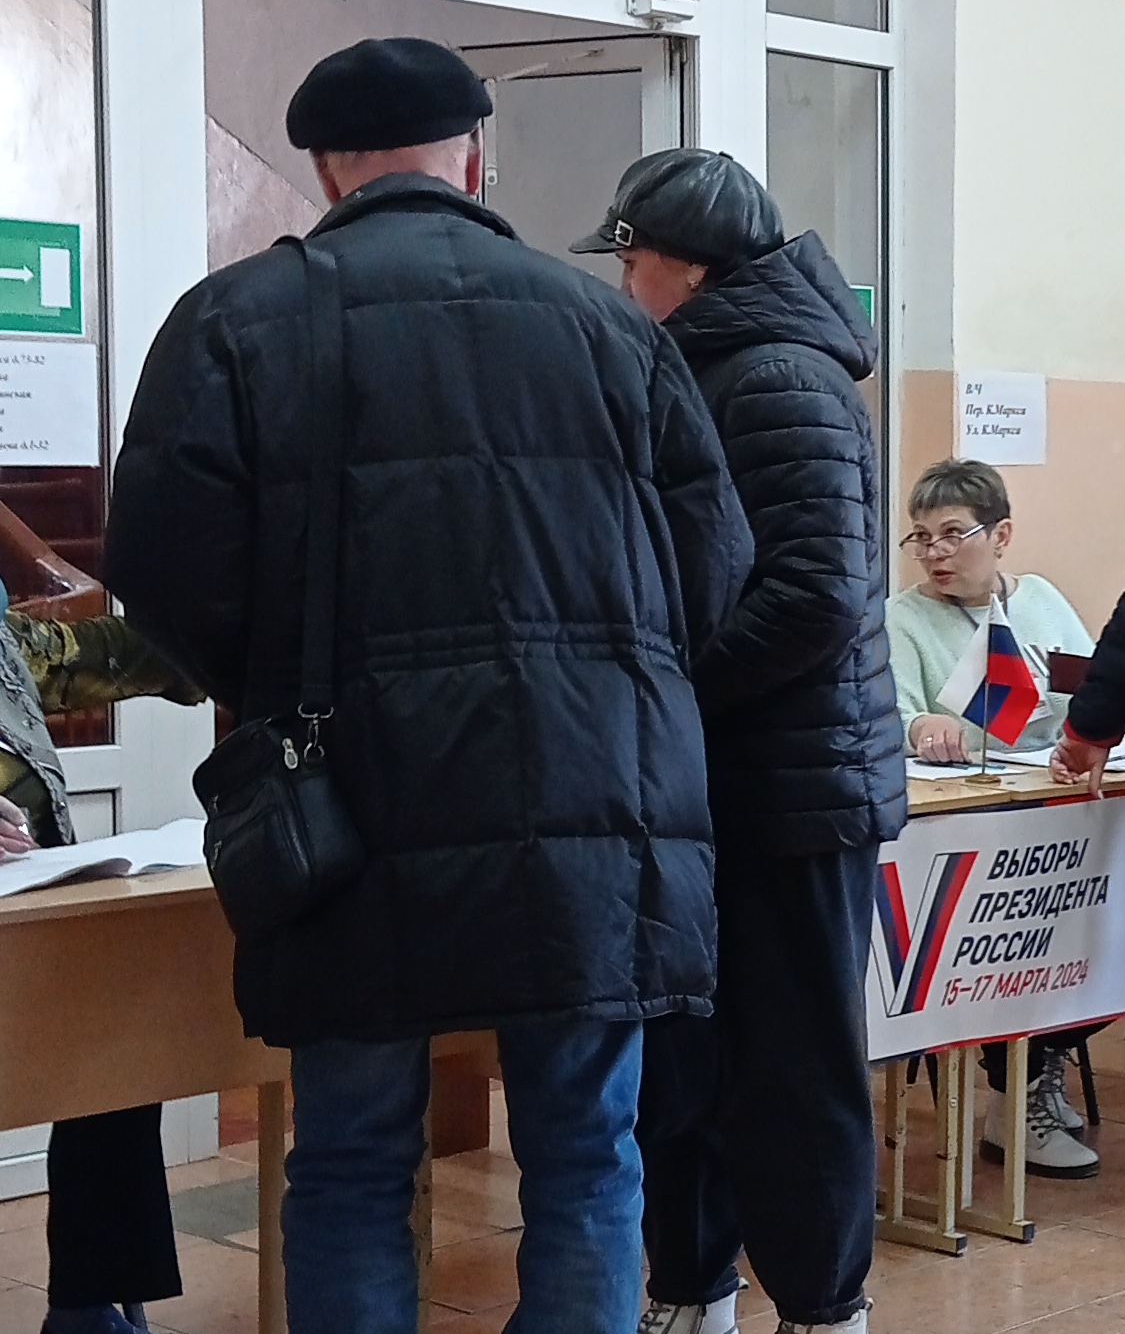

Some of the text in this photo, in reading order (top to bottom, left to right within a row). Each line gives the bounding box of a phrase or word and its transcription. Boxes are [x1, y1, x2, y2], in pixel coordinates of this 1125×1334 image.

[987, 837, 1090, 880] ВЫБОРЫ
[968, 874, 1109, 924] ПРЕЗИДЕНТА
[952, 926, 1055, 967] РОССИИ
[991, 966, 1052, 1000] МАРТА
[1051, 957, 1090, 990] 2024
